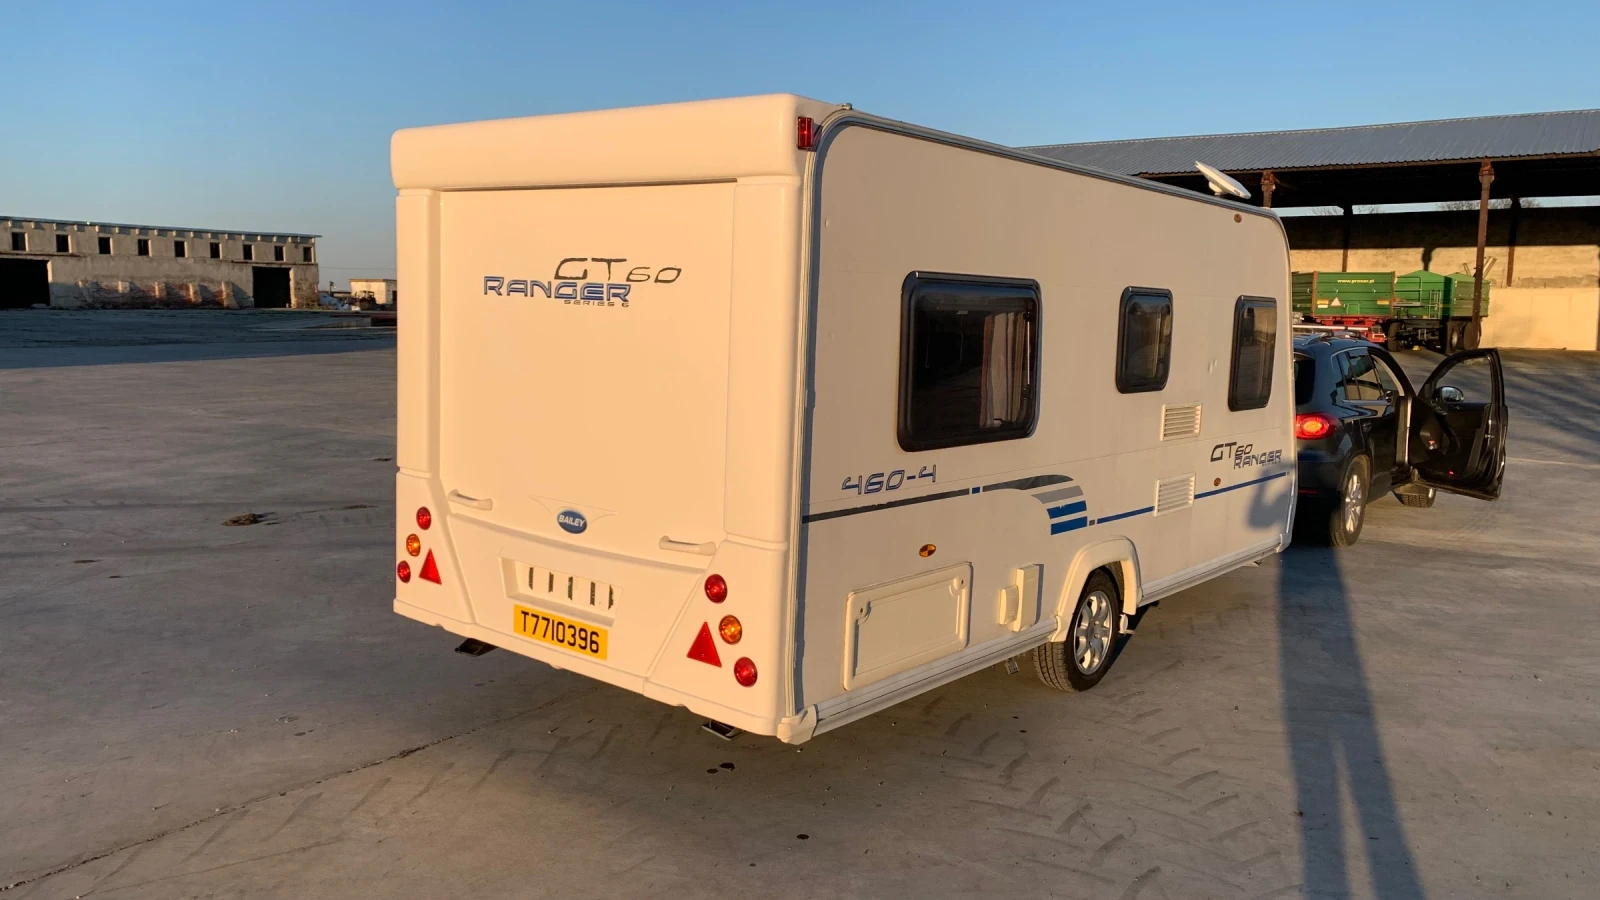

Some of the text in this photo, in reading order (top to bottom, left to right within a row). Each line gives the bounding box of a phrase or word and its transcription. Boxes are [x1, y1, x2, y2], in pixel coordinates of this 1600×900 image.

[483, 276, 632, 302] RANGER
[564, 299, 615, 307] SERIES
[1233, 449, 1283, 470] RANGER
[841, 464, 937, 495] 460-4
[558, 514, 586, 527] BAILEY
[520, 610, 600, 654] T7710396
